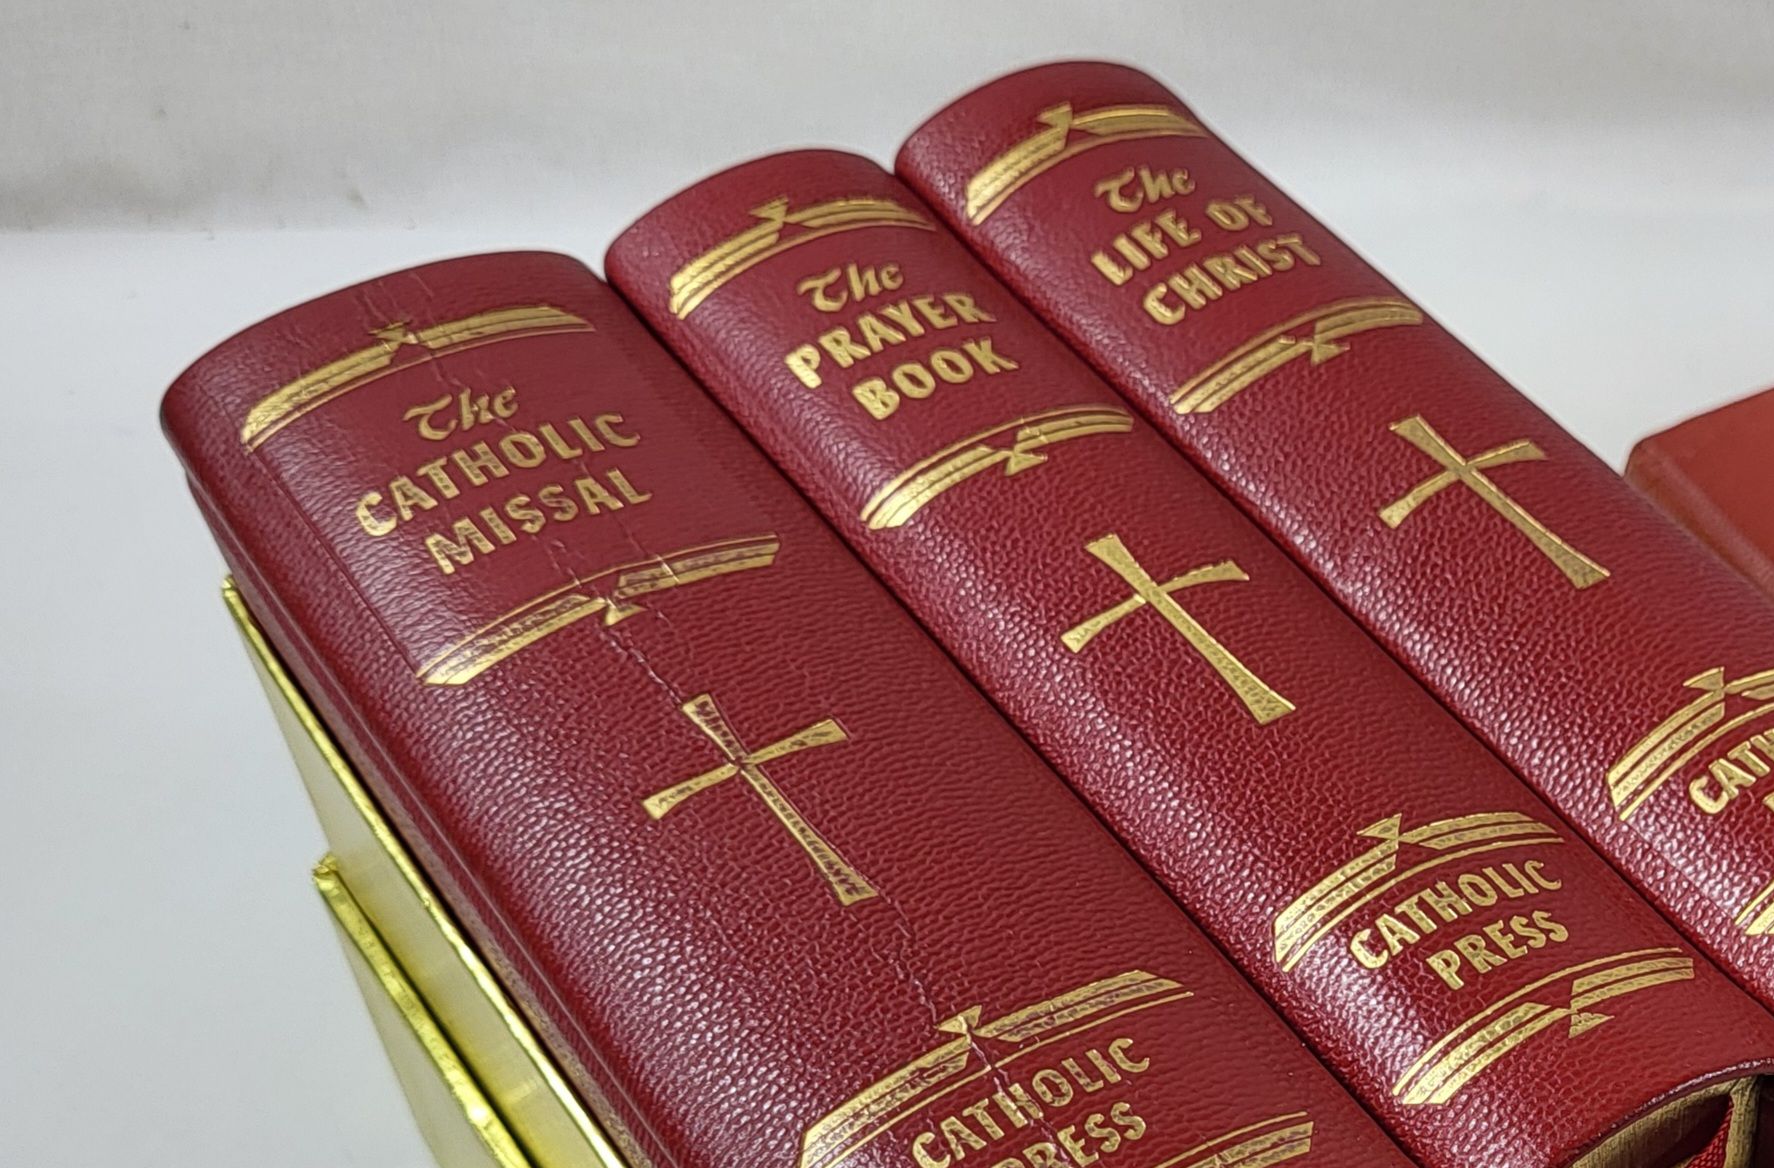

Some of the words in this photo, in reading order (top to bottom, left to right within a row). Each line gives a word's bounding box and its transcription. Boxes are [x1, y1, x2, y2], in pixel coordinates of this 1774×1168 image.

[1096, 166, 1195, 215] The
[1090, 209, 1202, 286] LIFE
[1205, 193, 1275, 247] OF
[1141, 232, 1321, 325] CHRIST
[798, 263, 904, 312] The
[784, 291, 997, 389] PRAYER
[852, 337, 1019, 420] BOOK
[404, 386, 517, 441] The
[354, 413, 640, 537] CATHOLIC
[424, 468, 653, 575] MISSAL
[1348, 860, 1562, 969] CATHOLIC
[1426, 909, 1569, 990] PRESS
